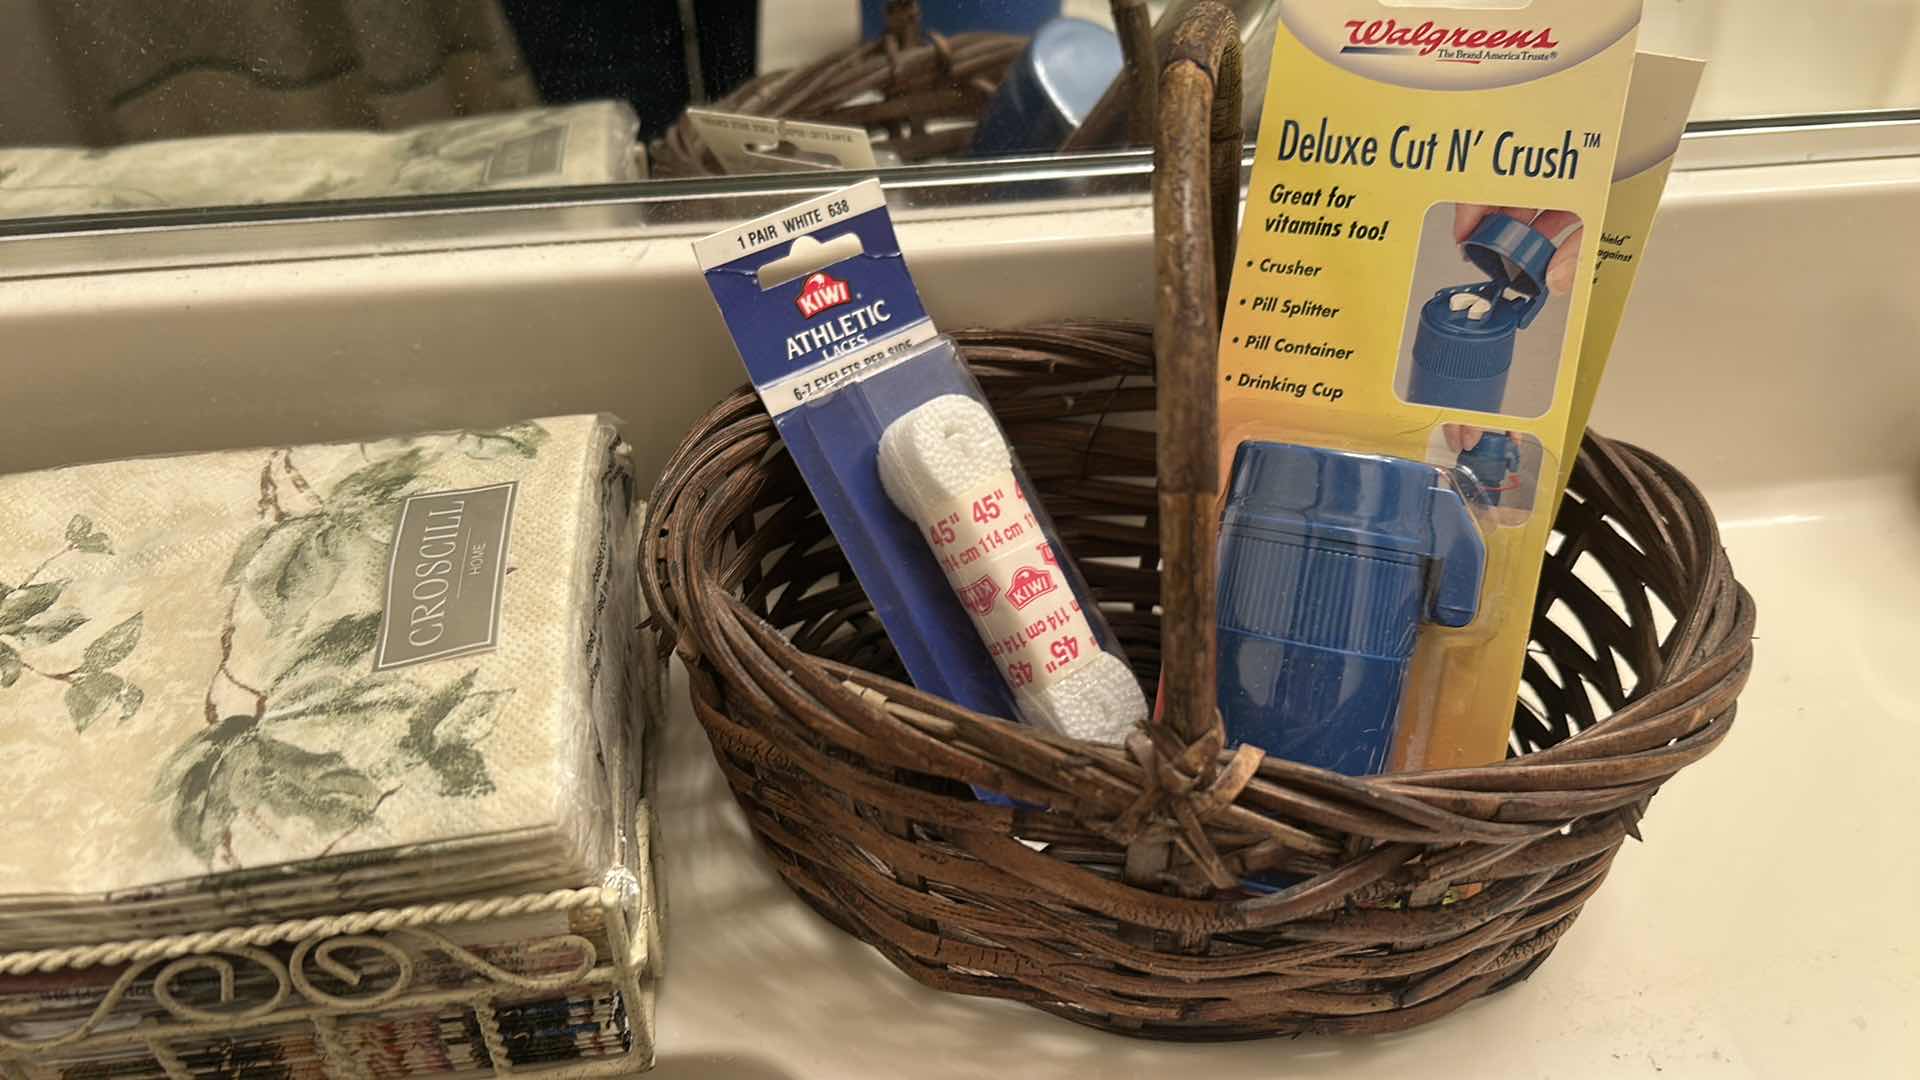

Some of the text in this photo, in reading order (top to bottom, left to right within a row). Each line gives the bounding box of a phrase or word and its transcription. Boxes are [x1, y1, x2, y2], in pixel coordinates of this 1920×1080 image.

[1344, 19, 1558, 56] Walgreens
[1438, 49, 1454, 59] The
[1456, 49, 1482, 60] Brand
[1483, 50, 1520, 61] America
[1278, 116, 1378, 166] Deluxe
[1390, 125, 1438, 170] Cut
[1269, 184, 1356, 208] Great for
[737, 200, 850, 250] 1 PAIR WHITE 638
[1265, 213, 1389, 241] vitamins too!
[1259, 259, 1322, 277] Crusher
[800, 282, 848, 315] KIWI
[1252, 297, 1340, 318] Pill Splitter
[786, 300, 892, 360] ATHLETIC
[822, 334, 869, 361] LACES
[1245, 336, 1354, 360] Pill Container
[793, 383, 812, 401] 6-7
[1238, 374, 1344, 402] Drinking Cup
[972, 488, 1004, 524] 45"
[960, 547, 980, 565] cm
[979, 533, 1004, 554] 114
[1004, 522, 1024, 541] cm
[409, 500, 464, 646] CROSCILL
[469, 543, 486, 576] HOME
[1012, 573, 1050, 605] KIWI
[1025, 619, 1046, 641] cm
[1049, 608, 1071, 631] 114
[1045, 635, 1079, 673] 45"
